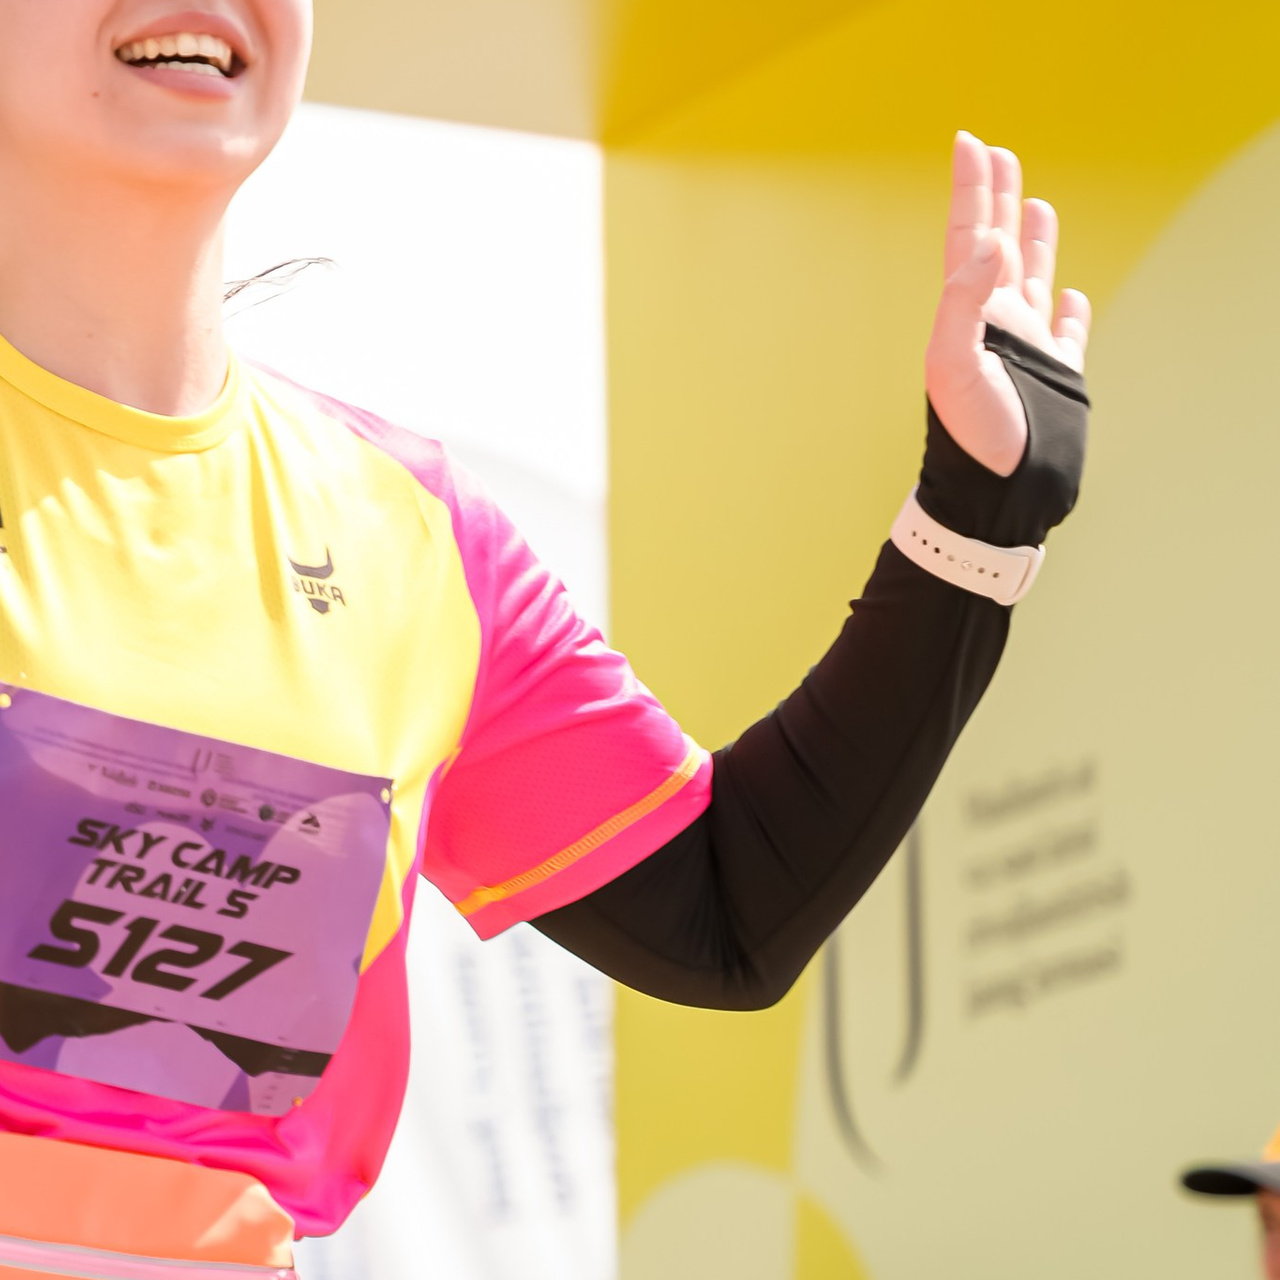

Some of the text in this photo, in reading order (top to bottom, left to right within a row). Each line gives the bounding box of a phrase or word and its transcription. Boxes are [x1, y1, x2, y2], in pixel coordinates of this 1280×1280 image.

[67, 817, 301, 889] SKY CAMP
[86, 857, 208, 910] TRAIL
[25, 898, 296, 1002] 5127
